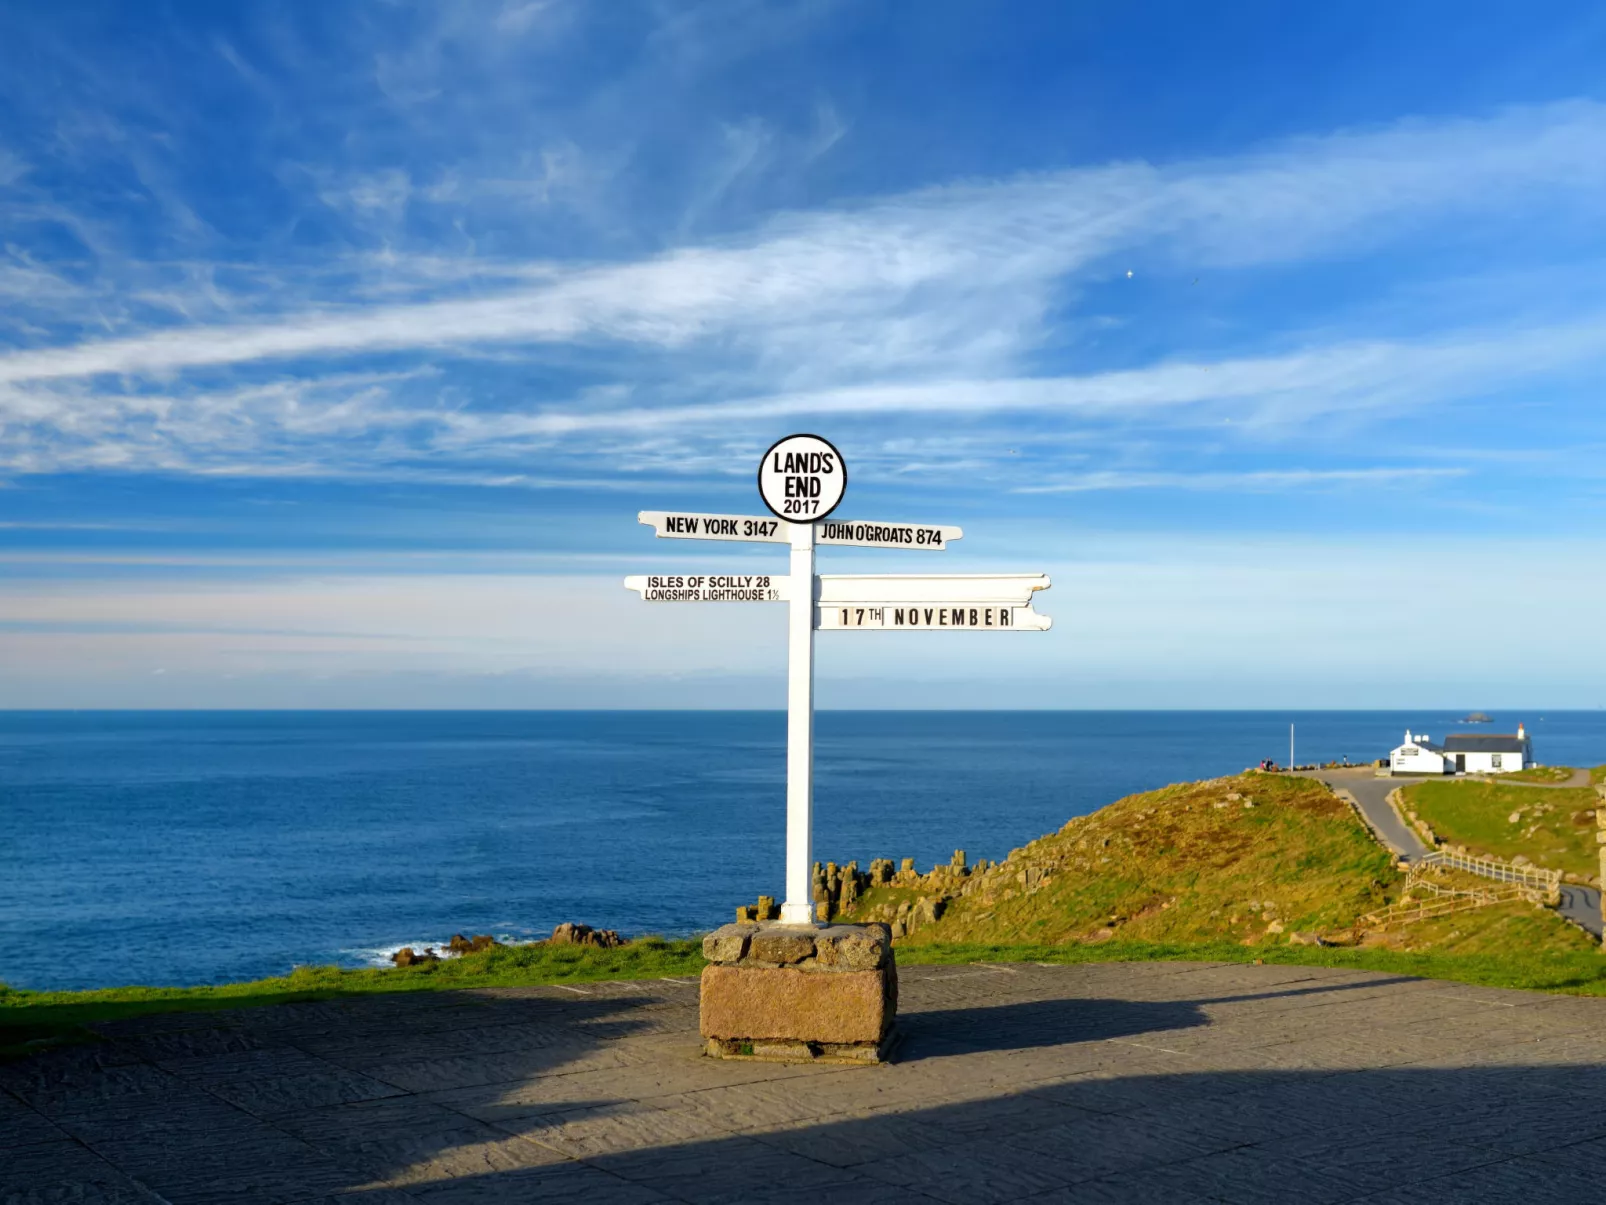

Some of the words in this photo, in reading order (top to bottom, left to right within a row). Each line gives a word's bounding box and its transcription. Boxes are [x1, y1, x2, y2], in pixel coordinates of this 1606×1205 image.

[774, 452, 834, 474] LAND'S
[784, 476, 821, 498] END
[783, 500, 820, 515] 2017
[666, 516, 698, 534] NEW
[703, 518, 738, 536] YORK
[743, 520, 778, 537] 3147
[821, 523, 853, 540] JOHN
[855, 523, 913, 544] O'GROATS
[916, 528, 942, 545] 874
[647, 577, 683, 588] ISLES
[687, 577, 704, 588] OF
[708, 577, 752, 588] SCILLY
[756, 577, 770, 588] 28
[645, 589, 700, 600] LONGSHIPS
[702, 589, 764, 600] LIGHTHOUSE
[894, 608, 1009, 626] NOVEMBER
